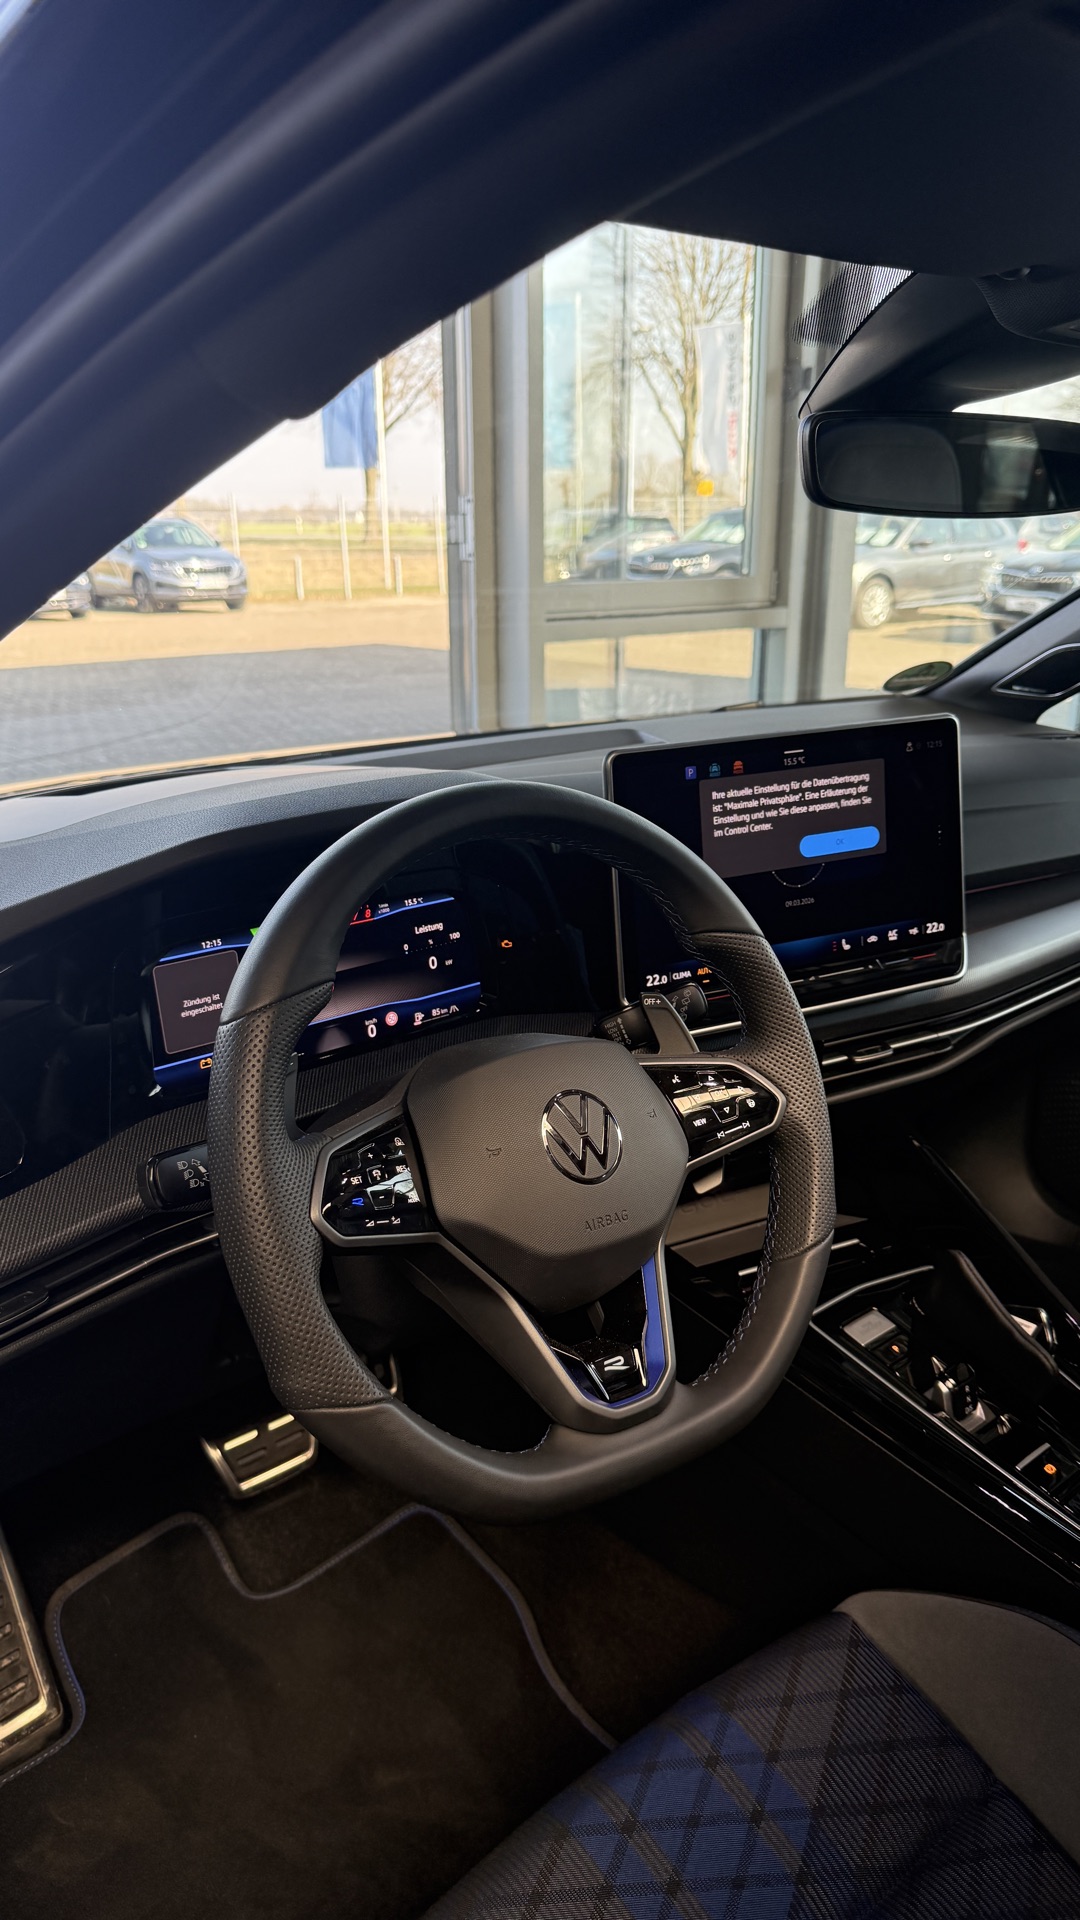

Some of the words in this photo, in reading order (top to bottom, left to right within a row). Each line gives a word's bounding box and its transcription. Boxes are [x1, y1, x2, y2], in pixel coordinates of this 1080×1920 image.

[712, 791, 726, 800] Ihre
[727, 787, 753, 798] aktuelle
[754, 783, 790, 795] Einstellung
[791, 781, 801, 790] für
[802, 780, 812, 789] die
[813, 774, 870, 787] Datenübertragung
[805, 792, 819, 800] Eine
[820, 787, 857, 798] Erläuterung
[858, 785, 868, 793] der
[713, 814, 750, 825] Einstellung
[751, 810, 764, 820] und
[765, 809, 778, 818] wie
[779, 807, 789, 816] Sie
[790, 806, 807, 814] diese
[808, 802, 840, 812] anpassen,
[841, 798, 861, 807] finden
[862, 796, 872, 804] Sie
[714, 829, 723, 837] im
[724, 825, 749, 836] Control
[750, 823, 773, 832] Center.
[836, 838, 845, 846] OK
[405, 898, 418, 906] 15.5
[785, 897, 815, 908] 09.03.2026
[415, 922, 444, 935] Leistung
[926, 922, 945, 934] 22.0
[449, 932, 461, 940] 100
[201, 939, 222, 949] 12:15
[429, 956, 438, 970] 0
[646, 974, 668, 987] 22.0
[672, 970, 692, 980] CLIMA
[183, 995, 212, 1008] Zündung
[432, 1008, 441, 1017] 85
[367, 1024, 377, 1038] 0
[693, 1118, 707, 1127] VIEW
[351, 1176, 362, 1185] SET
[585, 1210, 629, 1231] AIRBAG
